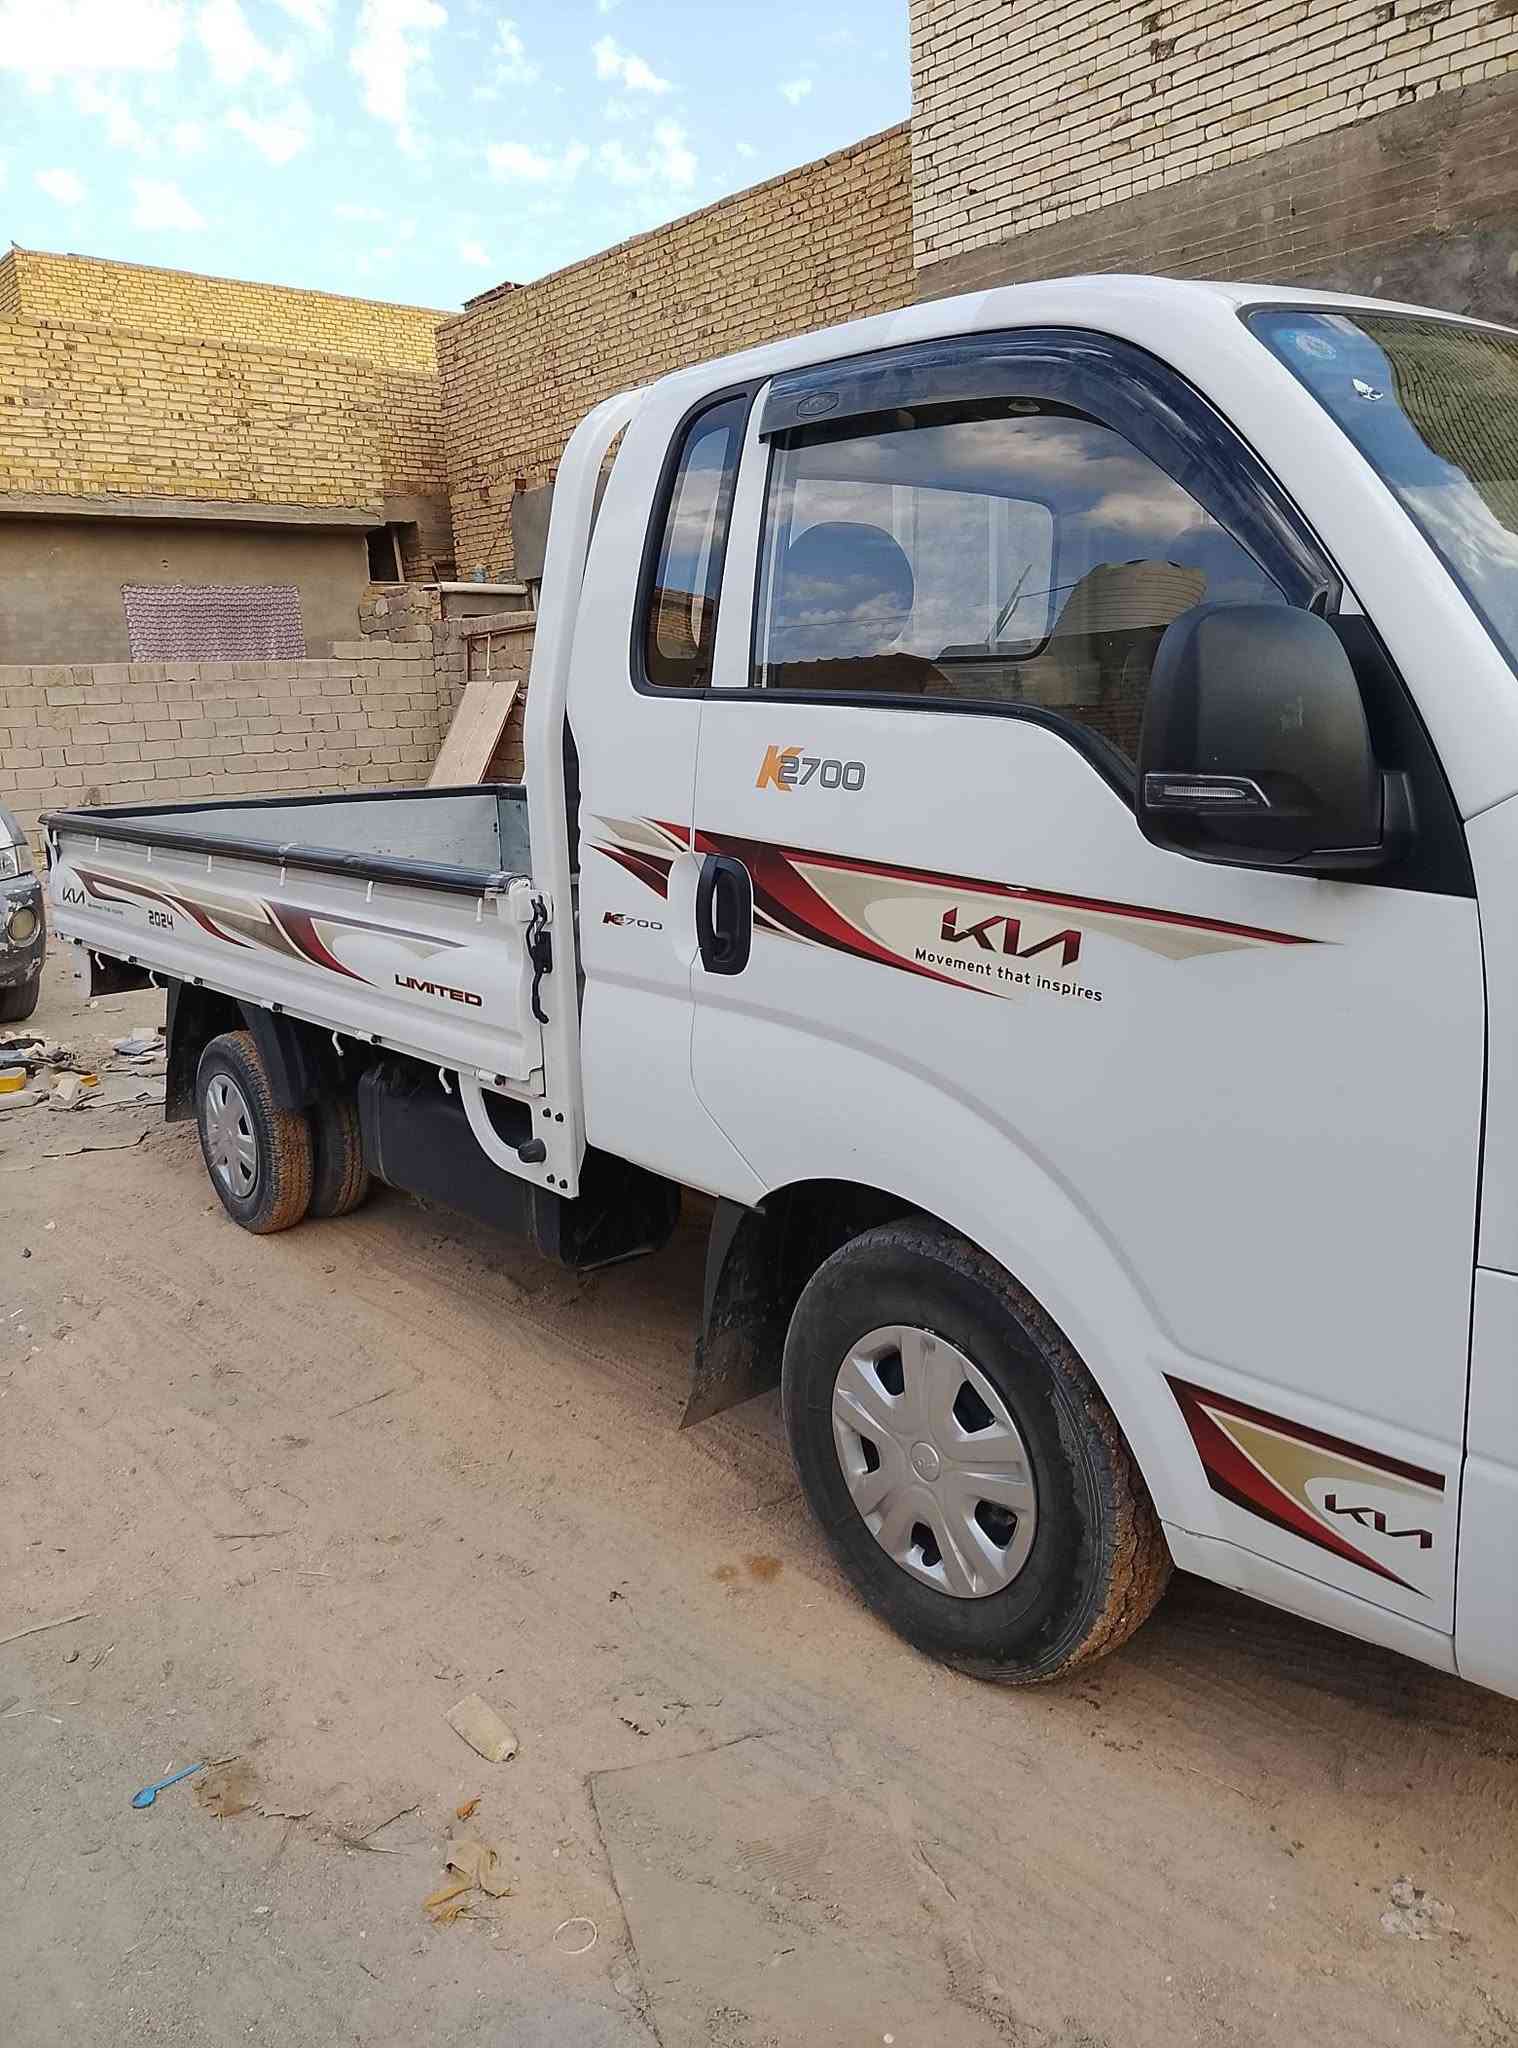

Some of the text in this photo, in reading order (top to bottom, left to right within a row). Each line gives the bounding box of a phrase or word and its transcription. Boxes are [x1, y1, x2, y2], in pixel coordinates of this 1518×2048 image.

[755, 745, 866, 791] K2700
[62, 887, 85, 904] KIA
[147, 910, 174, 930] 2024
[941, 907, 1081, 967] KIA
[394, 973, 483, 1007] LIMITED
[915, 948, 1103, 1002] Movement that inspires
[1325, 1494, 1432, 1549] KIA
